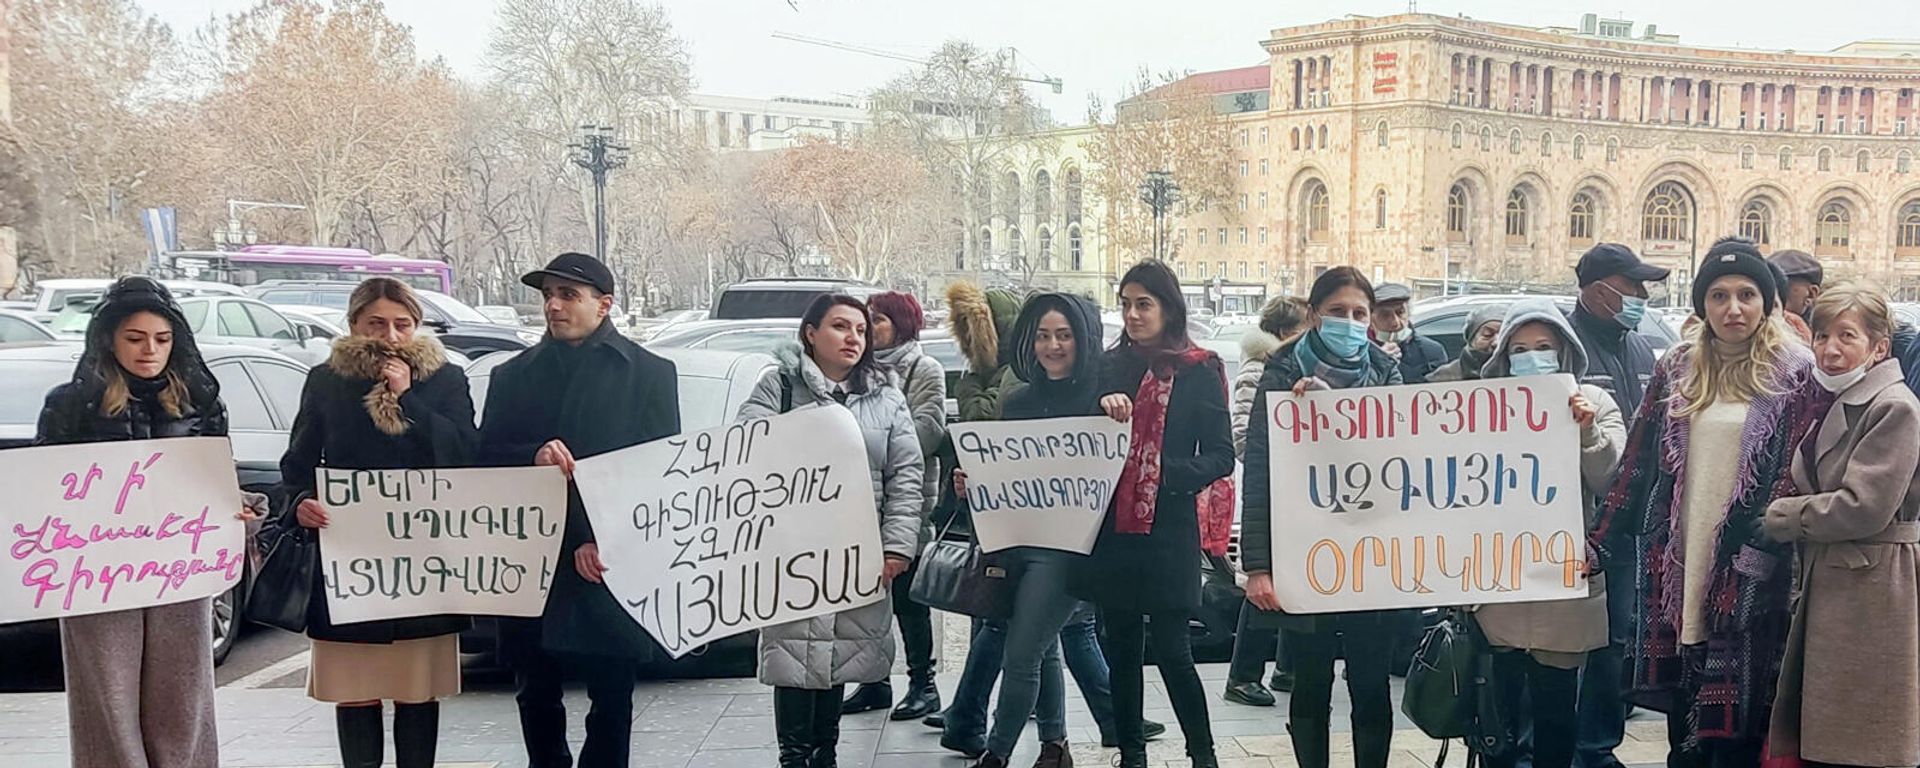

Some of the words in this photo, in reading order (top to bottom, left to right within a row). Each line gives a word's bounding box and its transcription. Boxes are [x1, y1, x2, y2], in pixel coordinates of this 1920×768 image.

[1273, 386, 1548, 444] ԳԻՏՈՒԹՅՈՒՆ
[324, 469, 452, 507] ԵՐԿՐԻ
[632, 465, 842, 542] ԳԻՏՈՒԹՅՈՒՆ
[1308, 452, 1557, 513] ԱԶԳԱՅԻՆ
[386, 505, 557, 540] ԱՊԱԳԱՆ
[323, 555, 527, 600] ՎՏԱՆԳՎԱԾ
[1306, 530, 1585, 595] ՕՐԱԿԱՐԳ
